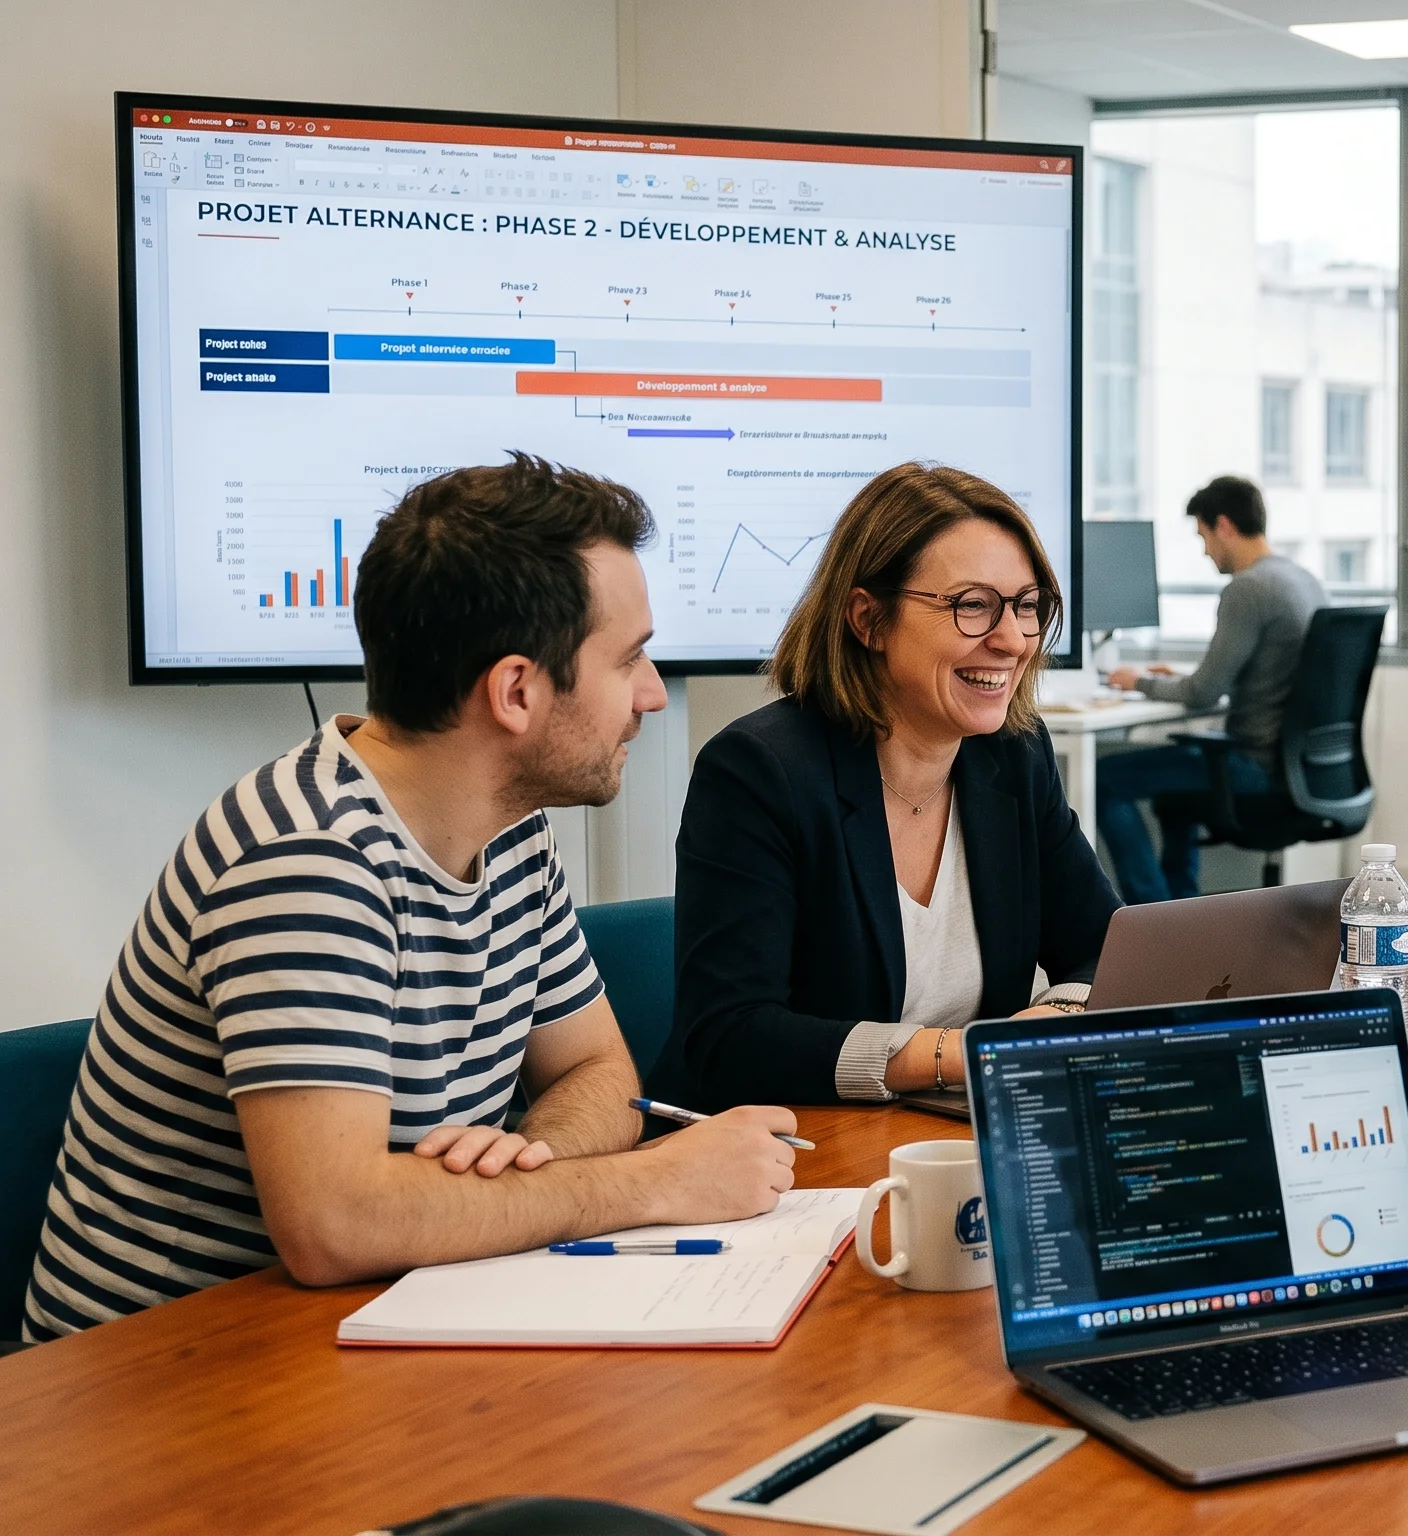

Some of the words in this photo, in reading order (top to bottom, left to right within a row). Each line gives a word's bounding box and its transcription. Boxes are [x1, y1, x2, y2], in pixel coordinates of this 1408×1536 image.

[198, 201, 299, 224] PROJET
[306, 207, 475, 233] ALTERNANCE
[496, 215, 577, 236] PHASE
[584, 219, 597, 237] 2
[620, 216, 827, 246] DÉVELOPPEMENT
[834, 230, 849, 247] &
[856, 230, 956, 251] ANALYSE
[391, 278, 422, 288] Phase
[501, 282, 530, 291] Phase
[532, 282, 538, 291] 2
[206, 372, 243, 383] Project
[719, 382, 728, 392] &
[364, 465, 399, 475] Project
